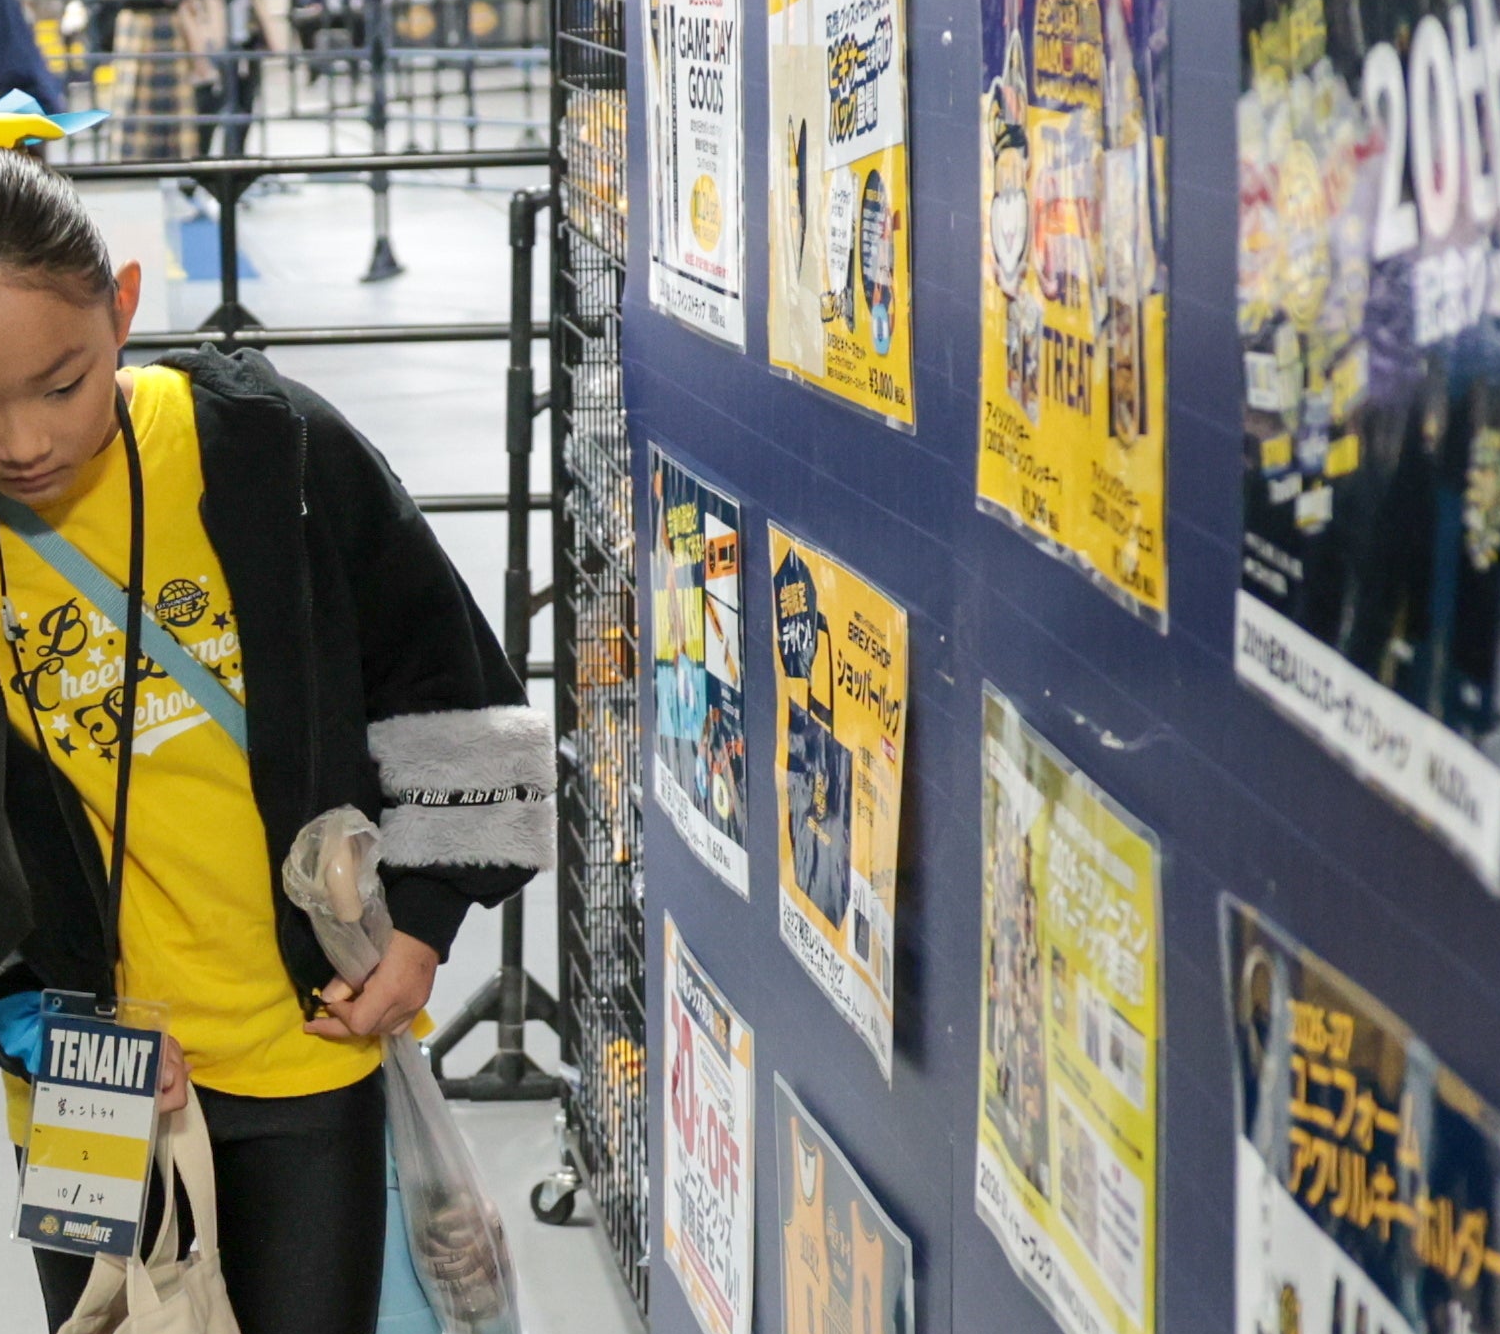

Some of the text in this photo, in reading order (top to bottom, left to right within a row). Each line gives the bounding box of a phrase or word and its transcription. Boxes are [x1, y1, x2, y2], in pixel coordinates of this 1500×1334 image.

[678, 16, 734, 65] GAME DAY
[688, 65, 725, 115] GOODS
[868, 367, 894, 403] ¥3,000
[1043, 325, 1095, 417] TREAT
[158, 593, 210, 620] BREX
[847, 621, 870, 652] BREX
[837, 648, 902, 738] ショッパーバッグ
[404, 788, 422, 805] GY
[422, 788, 451, 805] GIRL
[50, 1028, 154, 1090] TENANT
[82, 1150, 90, 1161] 2
[57, 1187, 68, 1199] 10
